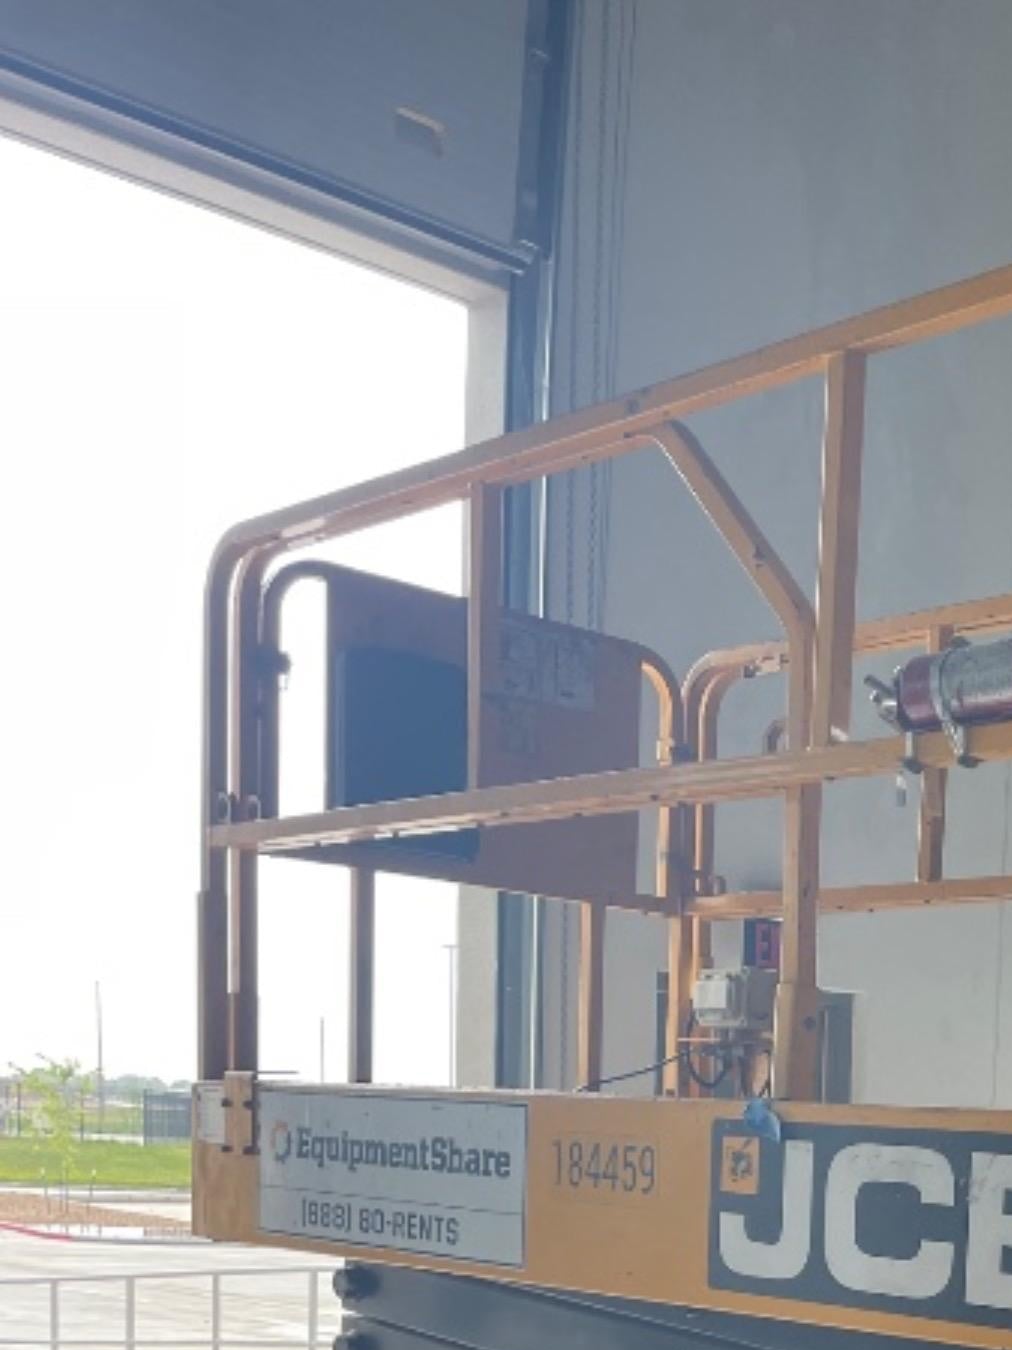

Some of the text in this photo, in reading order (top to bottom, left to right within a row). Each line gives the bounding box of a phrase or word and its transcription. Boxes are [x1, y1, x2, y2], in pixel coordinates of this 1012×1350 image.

[295, 1126, 512, 1179] EquipmentShare
[552, 1138, 656, 1195] 184459
[302, 1198, 460, 1246] (888) 80-RENTS
